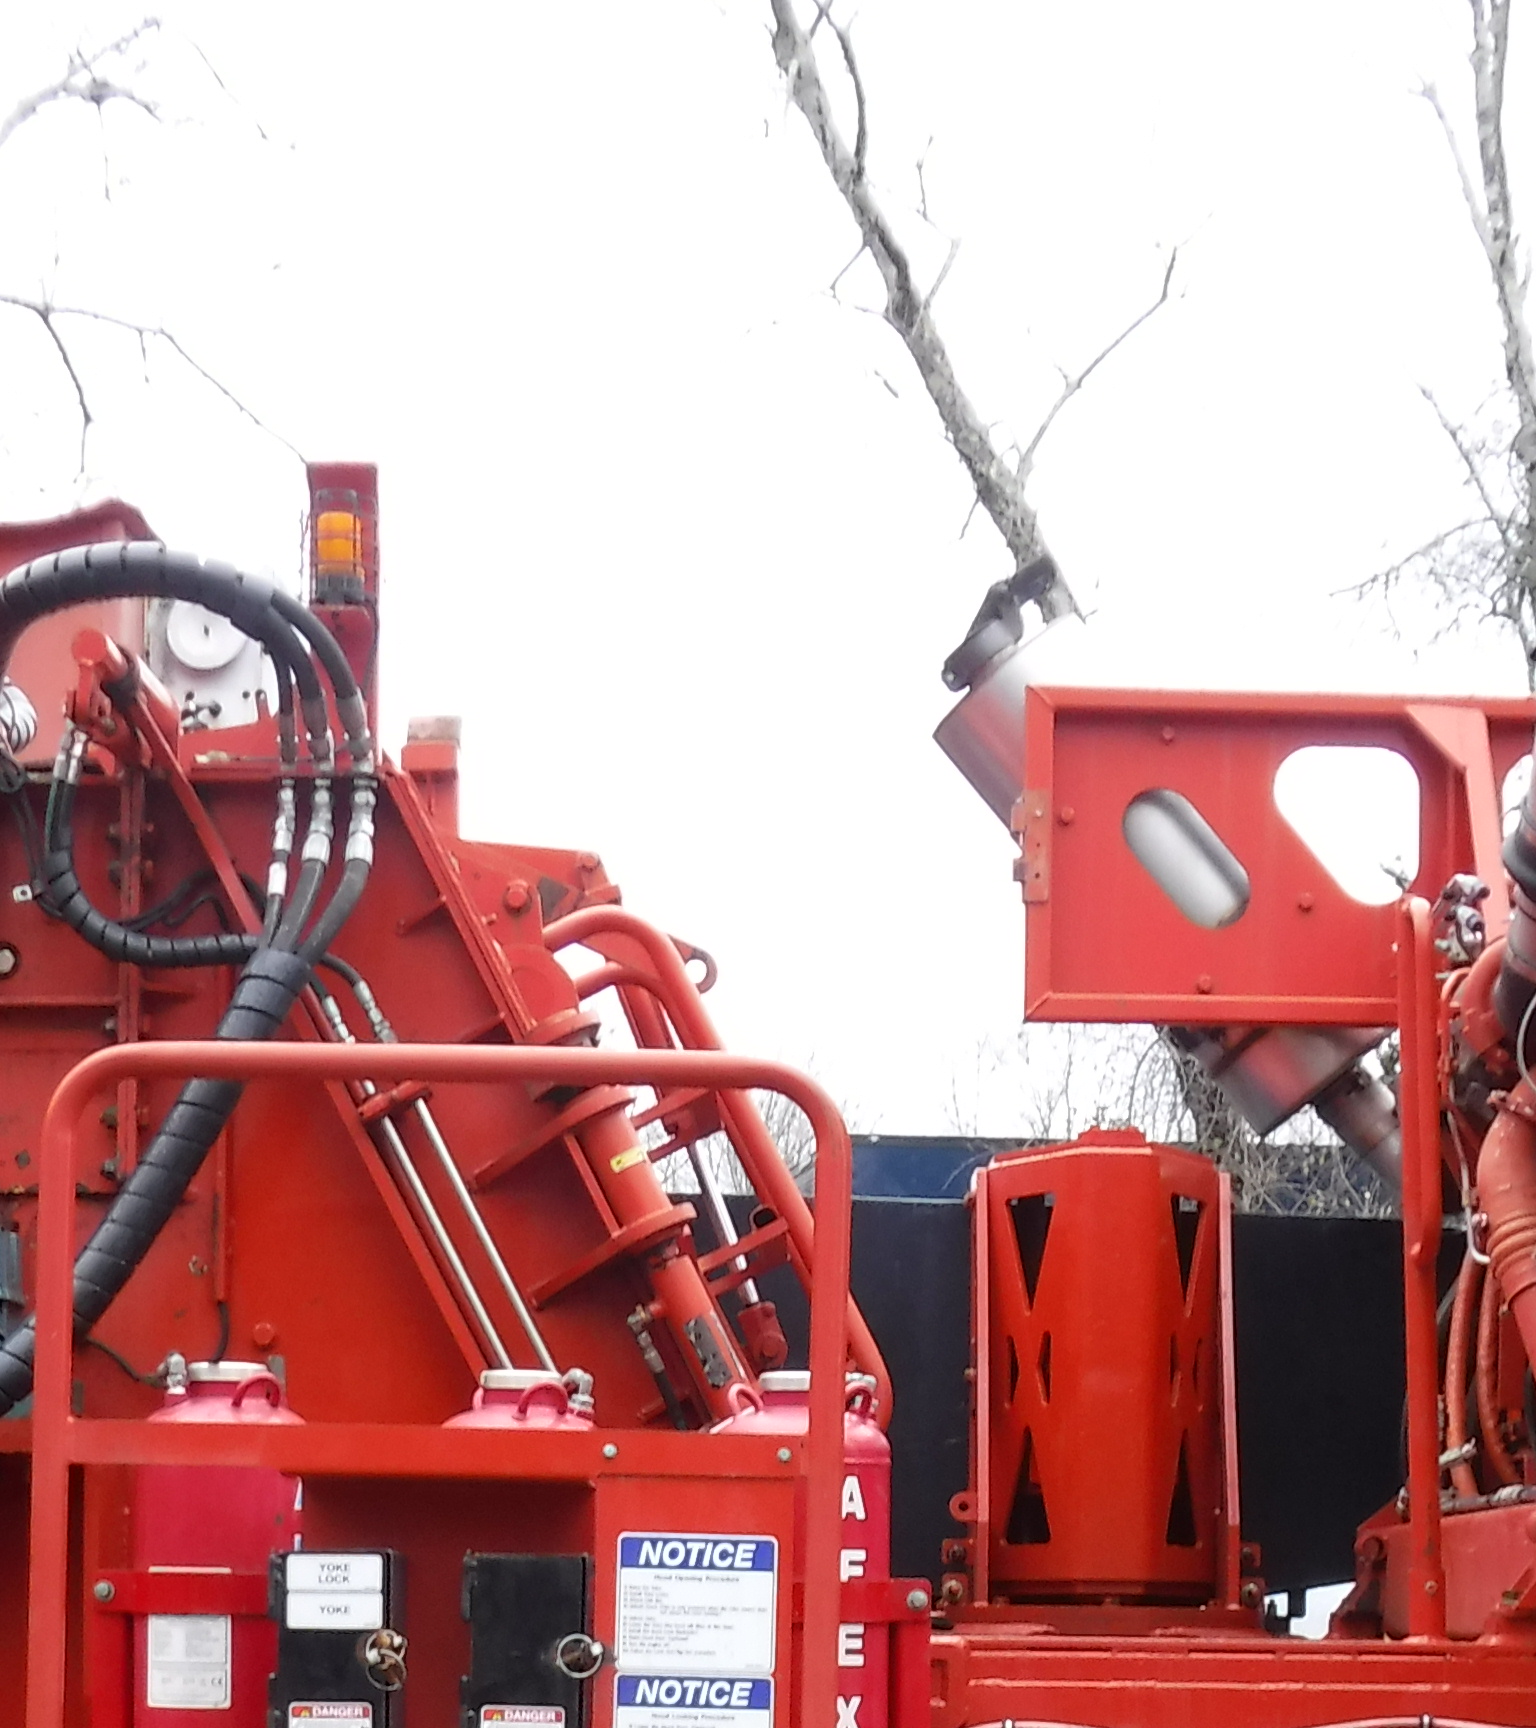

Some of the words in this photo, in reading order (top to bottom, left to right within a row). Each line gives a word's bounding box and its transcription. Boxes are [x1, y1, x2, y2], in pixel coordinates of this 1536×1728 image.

[638, 1540, 757, 1569] NOTICE
[319, 1563, 351, 1572] YOKE
[318, 1574, 350, 1584] LOCK
[320, 1605, 351, 1614] YOKE
[635, 1679, 753, 1707] NOTICE
[312, 1705, 364, 1718] DANGER
[504, 1710, 555, 1721] DANGER
